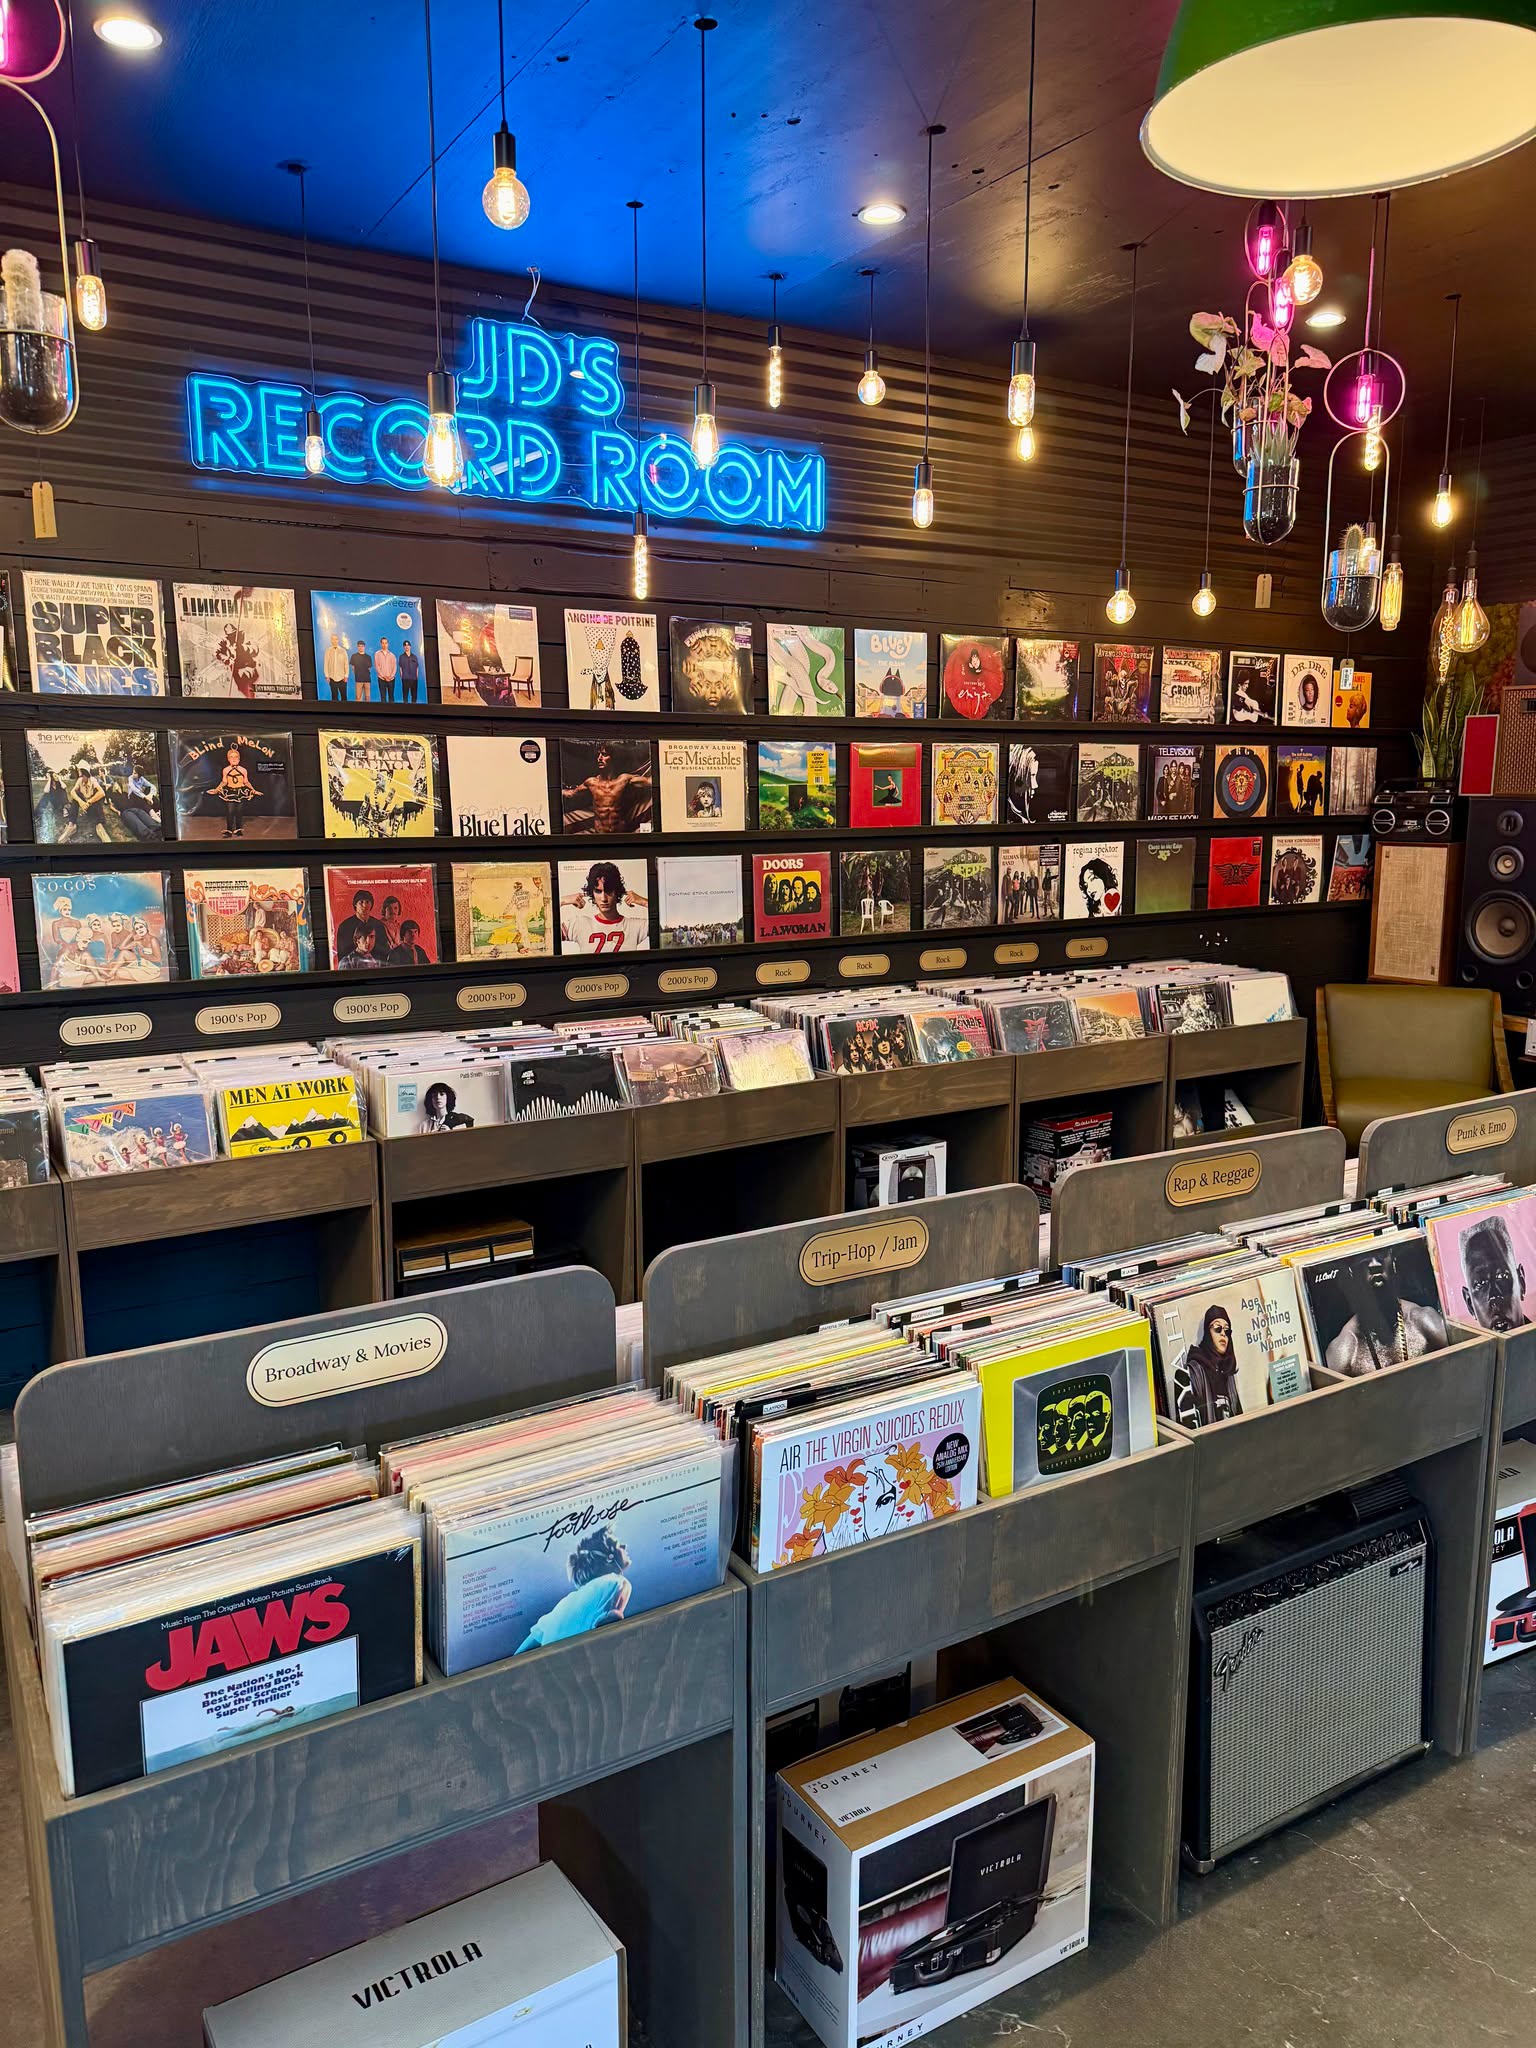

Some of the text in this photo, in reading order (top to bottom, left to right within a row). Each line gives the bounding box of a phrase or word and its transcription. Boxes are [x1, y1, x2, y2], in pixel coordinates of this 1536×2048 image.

[462, 319, 620, 417] JD'S
[193, 376, 825, 531] RECORD ROOM
[181, 597, 240, 618] LINKIN
[32, 600, 156, 638] SUPER
[567, 612, 655, 628] ANGINE DE POITRINE
[34, 632, 158, 668] BLACK
[870, 633, 913, 659] BLUEY
[1308, 660, 1328, 679] DRE
[37, 664, 160, 697] BLUES
[350, 749, 367, 759] THE
[664, 751, 742, 766] Les Misérables
[1158, 747, 1194, 757] TELEVISION
[459, 813, 545, 837] Blue Lake
[1072, 846, 1093, 857] regina
[1094, 843, 1119, 857] spektor
[762, 858, 804, 871] DOORS
[1009, 949, 1024, 958] Rock
[1079, 943, 1094, 953] Rock
[856, 961, 873, 971] Rock
[935, 956, 951, 965] Rock
[667, 974, 709, 986] 2000's Pop
[775, 968, 792, 978] Rock
[467, 991, 516, 1004] 2000's Pop
[575, 982, 620, 994] 2000's Pop
[346, 1001, 400, 1015] 1900's Pop
[76, 1021, 137, 1037] 1900's Pop
[210, 1013, 267, 1026] 1900's Pop
[229, 1077, 350, 1107] MEN AT WORK
[1456, 1122, 1507, 1142] Punk & Emo
[1173, 1166, 1255, 1196] Rap & Reggae
[811, 1242, 876, 1269] Trip-Hop
[891, 1234, 918, 1253] Jam
[1241, 1297, 1278, 1315] Age Ain't
[1252, 1310, 1291, 1331] Nothing
[1246, 1326, 1273, 1345] But A
[1260, 1333, 1297, 1353] Number
[265, 1334, 432, 1384] Broadway & Movies
[780, 1399, 965, 1473] AIR THE VIRGIN SUICIDES REDUX
[946, 1439, 960, 1450] NEW
[472, 1466, 701, 1536] ORIGINAL SOUNDTRACK OF THE PARAMOUNT MOTION PICTURE
[161, 1575, 333, 1631] Music From The Original Motion Picture Soundtrack
[145, 1582, 350, 1692] JAWS
[201, 1670, 304, 1709] Best-Selling Book
[203, 1663, 302, 1700] The Nation's No.1
[206, 1679, 301, 1715] now the Screen's
[215, 1690, 292, 1719] Super Thriller
[812, 1763, 879, 1794] JOURNEY
[838, 1805, 872, 1823] VICTROLA
[980, 1853, 1022, 1876] VICTROLA
[1059, 1936, 1085, 1955] VICTROLA
[351, 1942, 483, 2010] VICTROLA
